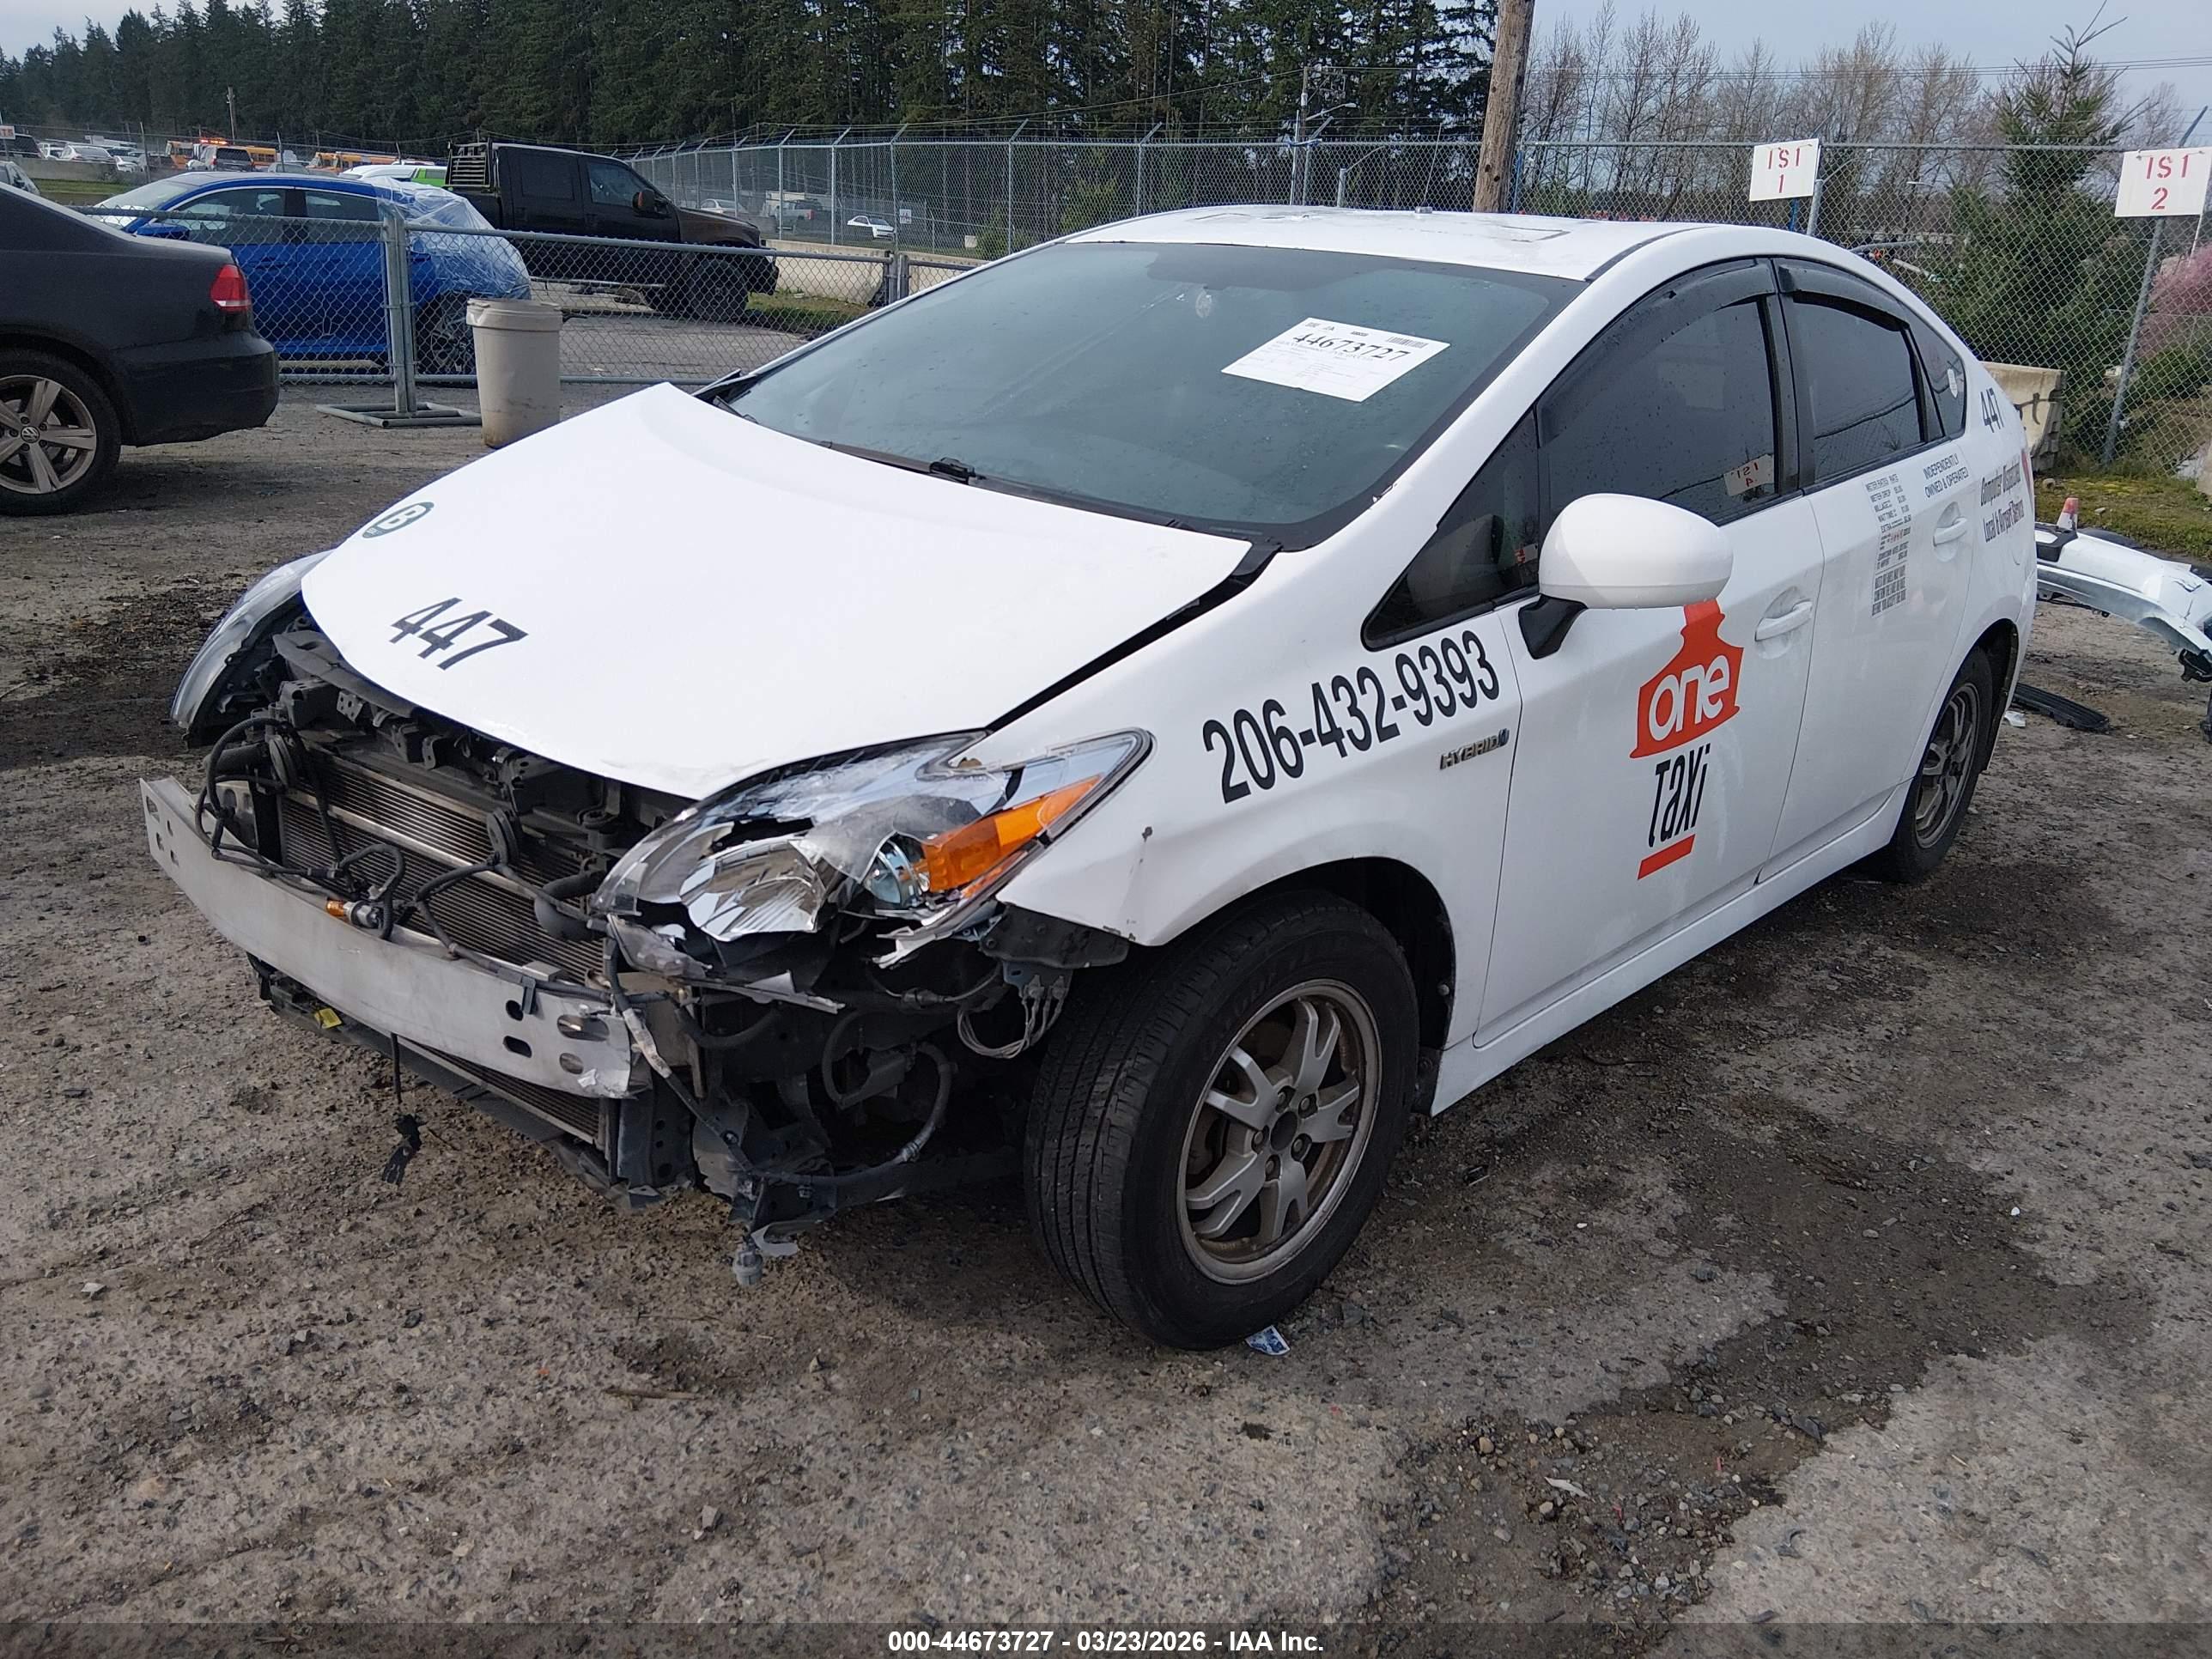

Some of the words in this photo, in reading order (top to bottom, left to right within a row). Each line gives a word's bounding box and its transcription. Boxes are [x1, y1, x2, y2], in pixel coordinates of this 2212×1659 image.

[2150, 186, 2169, 210] 2
[1292, 331, 1412, 362] 44673727
[1923, 453, 1959, 480] INDEPENDENTLY
[1924, 480, 1943, 498] OWNED
[1946, 466, 1969, 487] OPERATED
[388, 597, 530, 671] 447
[1648, 654, 1729, 741] one
[1201, 629, 1501, 805] 206-432-9393
[1439, 734, 1498, 771] HYBRID
